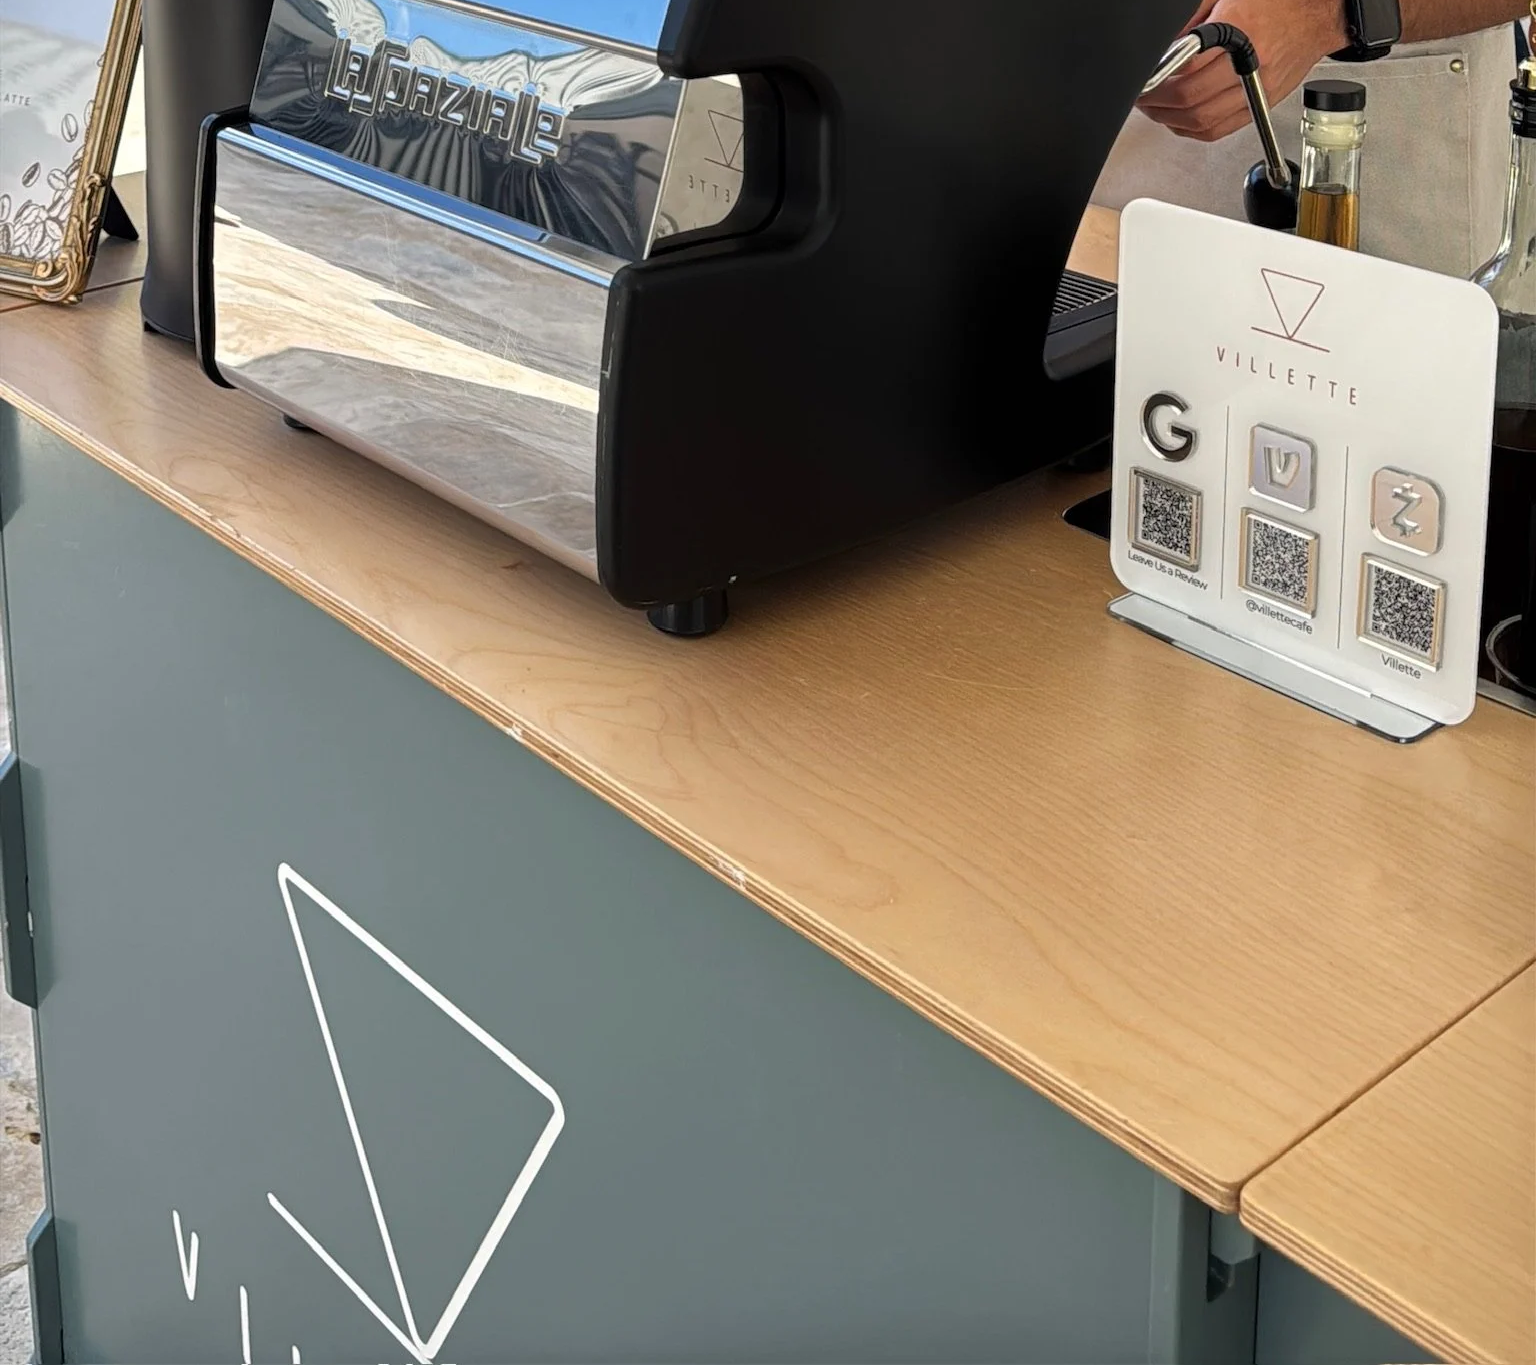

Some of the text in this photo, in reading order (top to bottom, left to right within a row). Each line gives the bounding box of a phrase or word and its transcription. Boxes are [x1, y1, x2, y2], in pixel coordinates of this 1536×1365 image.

[0, 92, 31, 107] ATTE
[1216, 345, 1357, 405] VILLETTE
[1128, 549, 1209, 591] Leave Us a Review
[1245, 598, 1313, 635] @villettecafe
[1380, 653, 1422, 680] Villette
